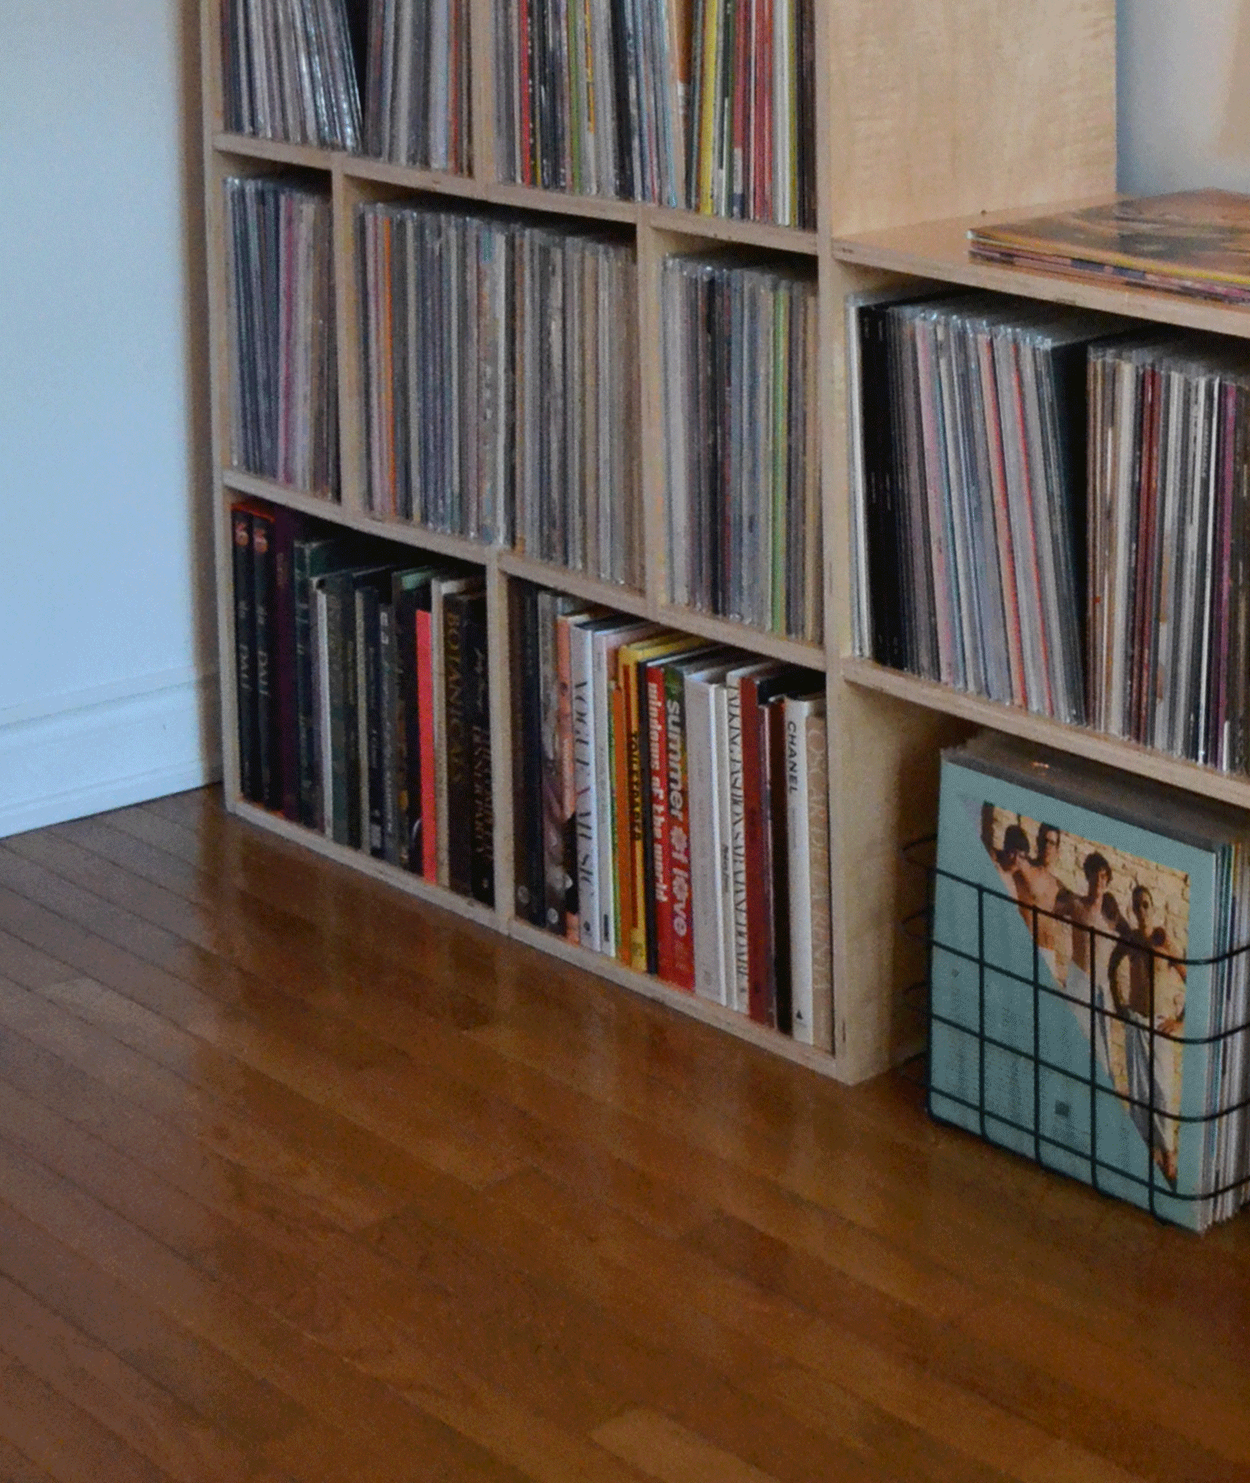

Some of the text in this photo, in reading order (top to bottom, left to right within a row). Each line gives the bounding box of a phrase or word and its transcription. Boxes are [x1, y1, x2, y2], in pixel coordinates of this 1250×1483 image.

[446, 611, 463, 784] BOTANICALS
[573, 679, 590, 776] VOGUE
[648, 682, 668, 902] windows of the world
[666, 698, 684, 821] summer
[786, 720, 799, 794] CHANEL
[670, 825, 689, 862] of
[808, 728, 828, 989] OSCAR DE LA RENTA
[672, 868, 689, 936] love
